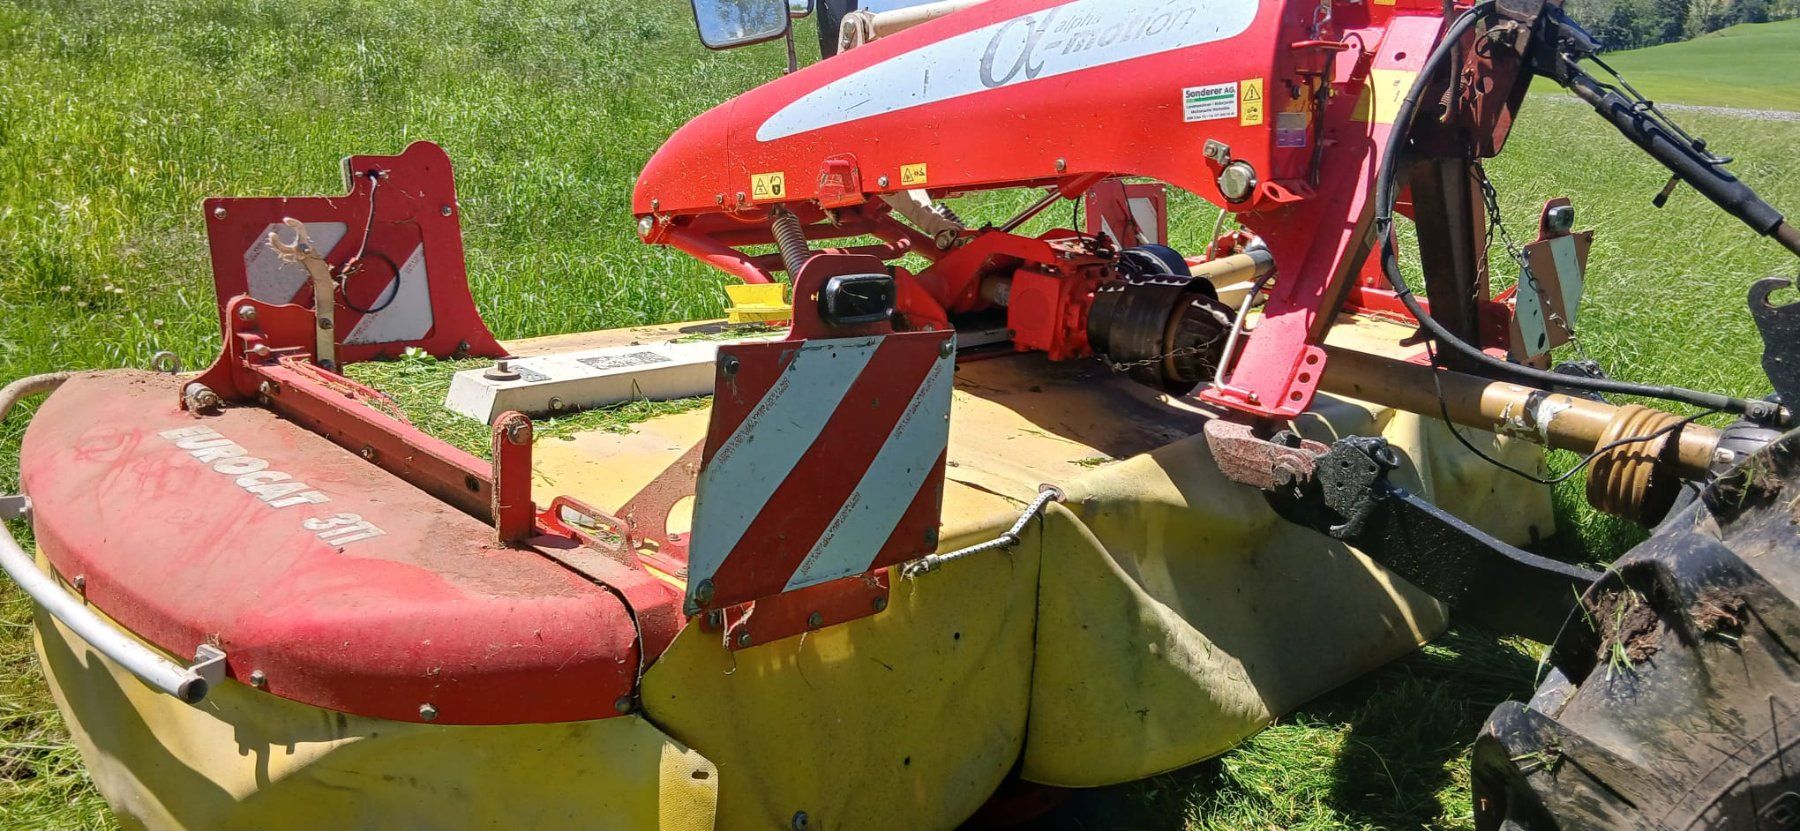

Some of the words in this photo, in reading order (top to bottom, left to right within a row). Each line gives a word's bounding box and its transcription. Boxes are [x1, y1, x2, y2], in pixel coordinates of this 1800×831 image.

[1054, 12, 1101, 33] alpha
[1185, 87, 1222, 98] Sonderer
[158, 425, 331, 508] EUROCAT
[303, 512, 387, 546] 311
